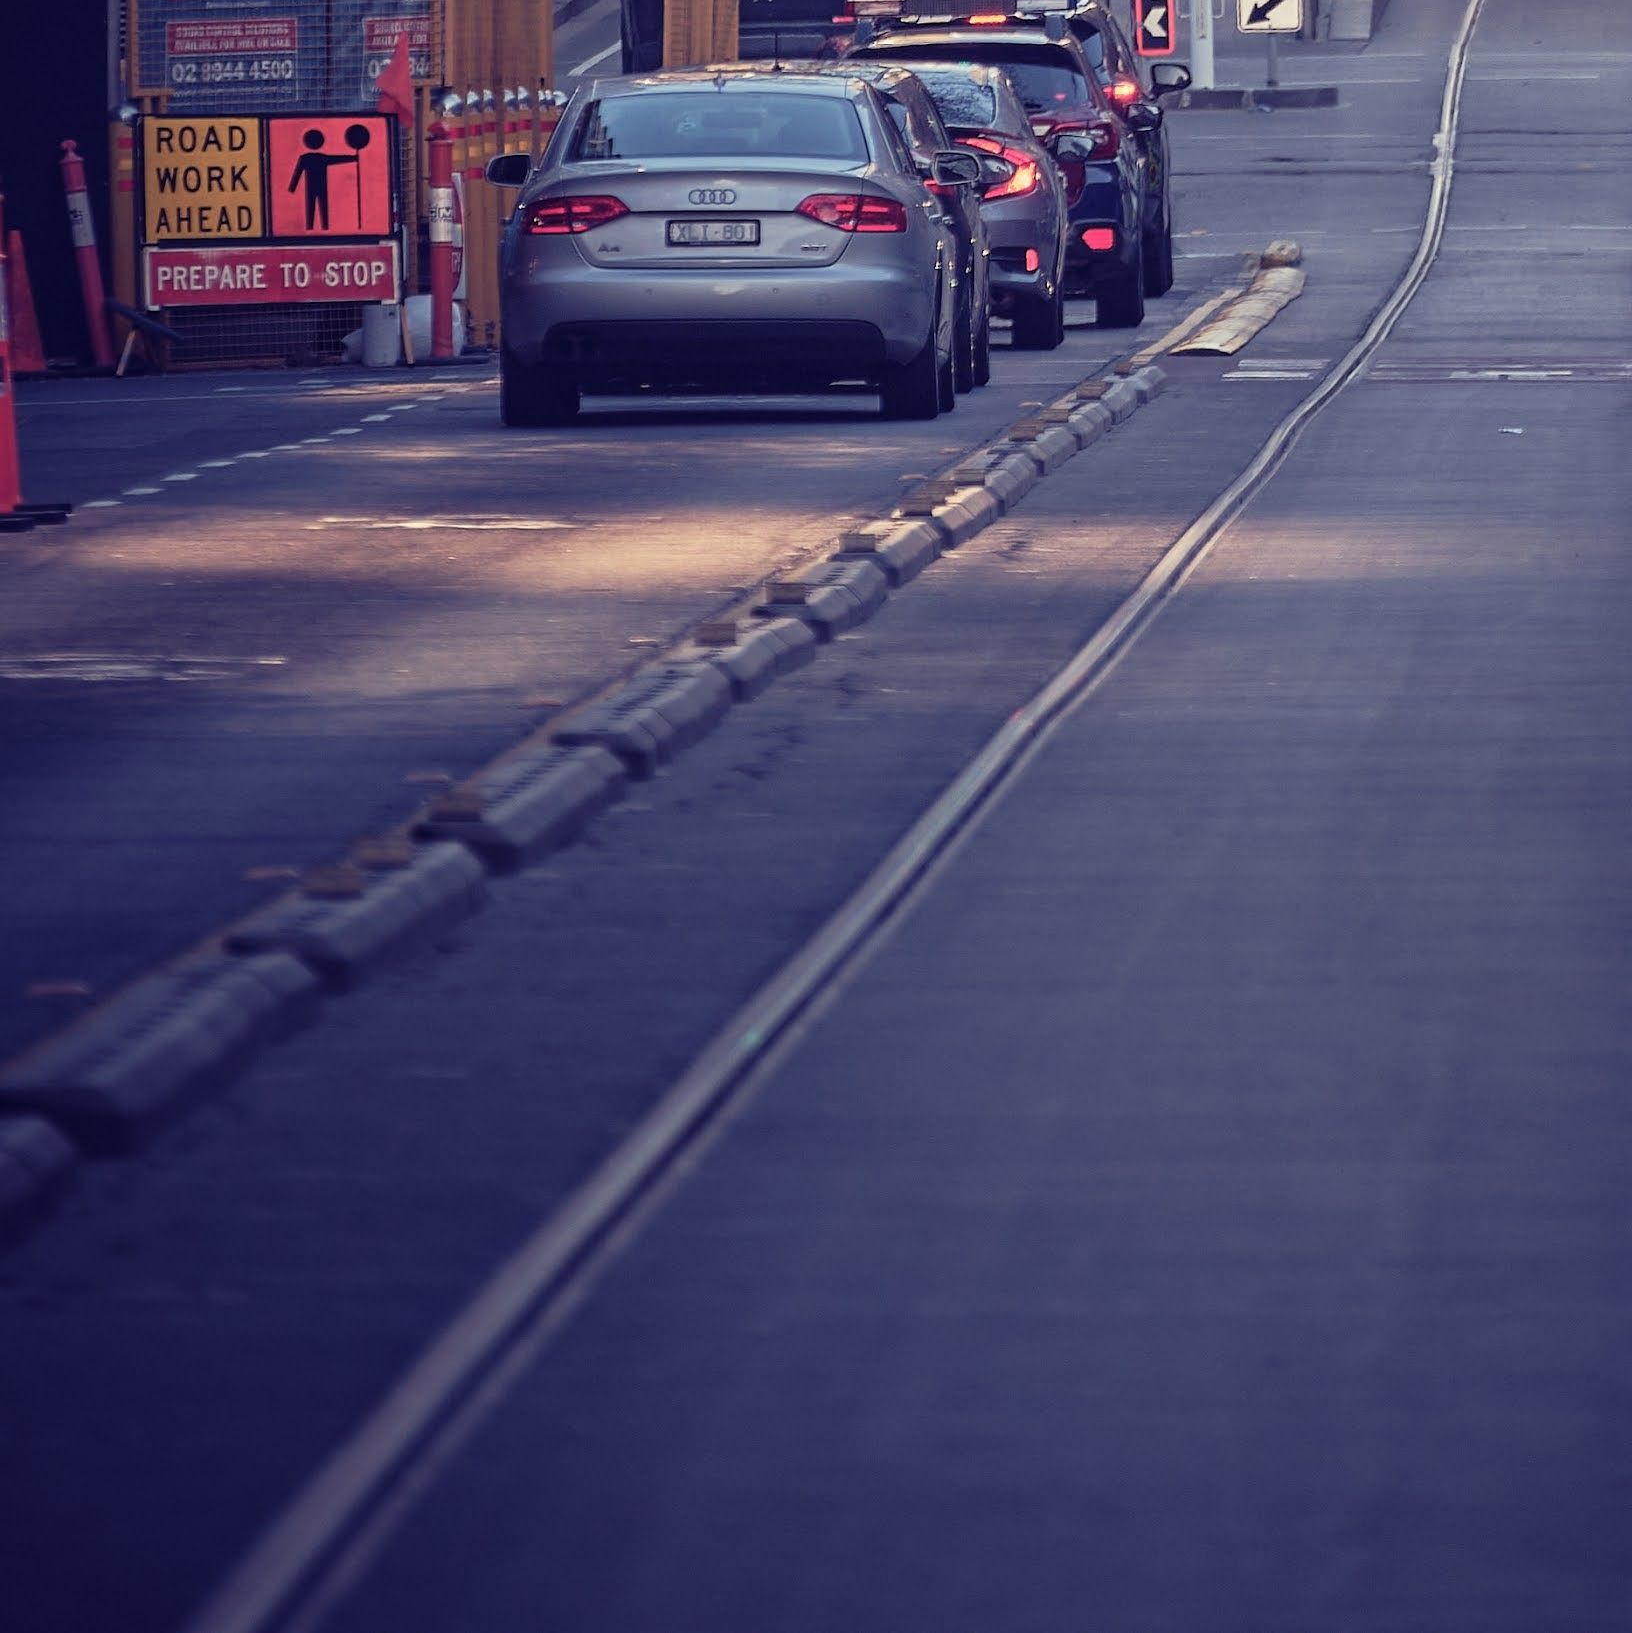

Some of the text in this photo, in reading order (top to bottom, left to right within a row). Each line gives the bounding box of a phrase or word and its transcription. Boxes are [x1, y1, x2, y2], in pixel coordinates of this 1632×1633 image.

[171, 63, 197, 84] 02
[156, 125, 247, 153] ROAD
[156, 166, 250, 194] WORK
[155, 205, 252, 233] AHEAD
[157, 260, 386, 291] PREPARE TO STOP
